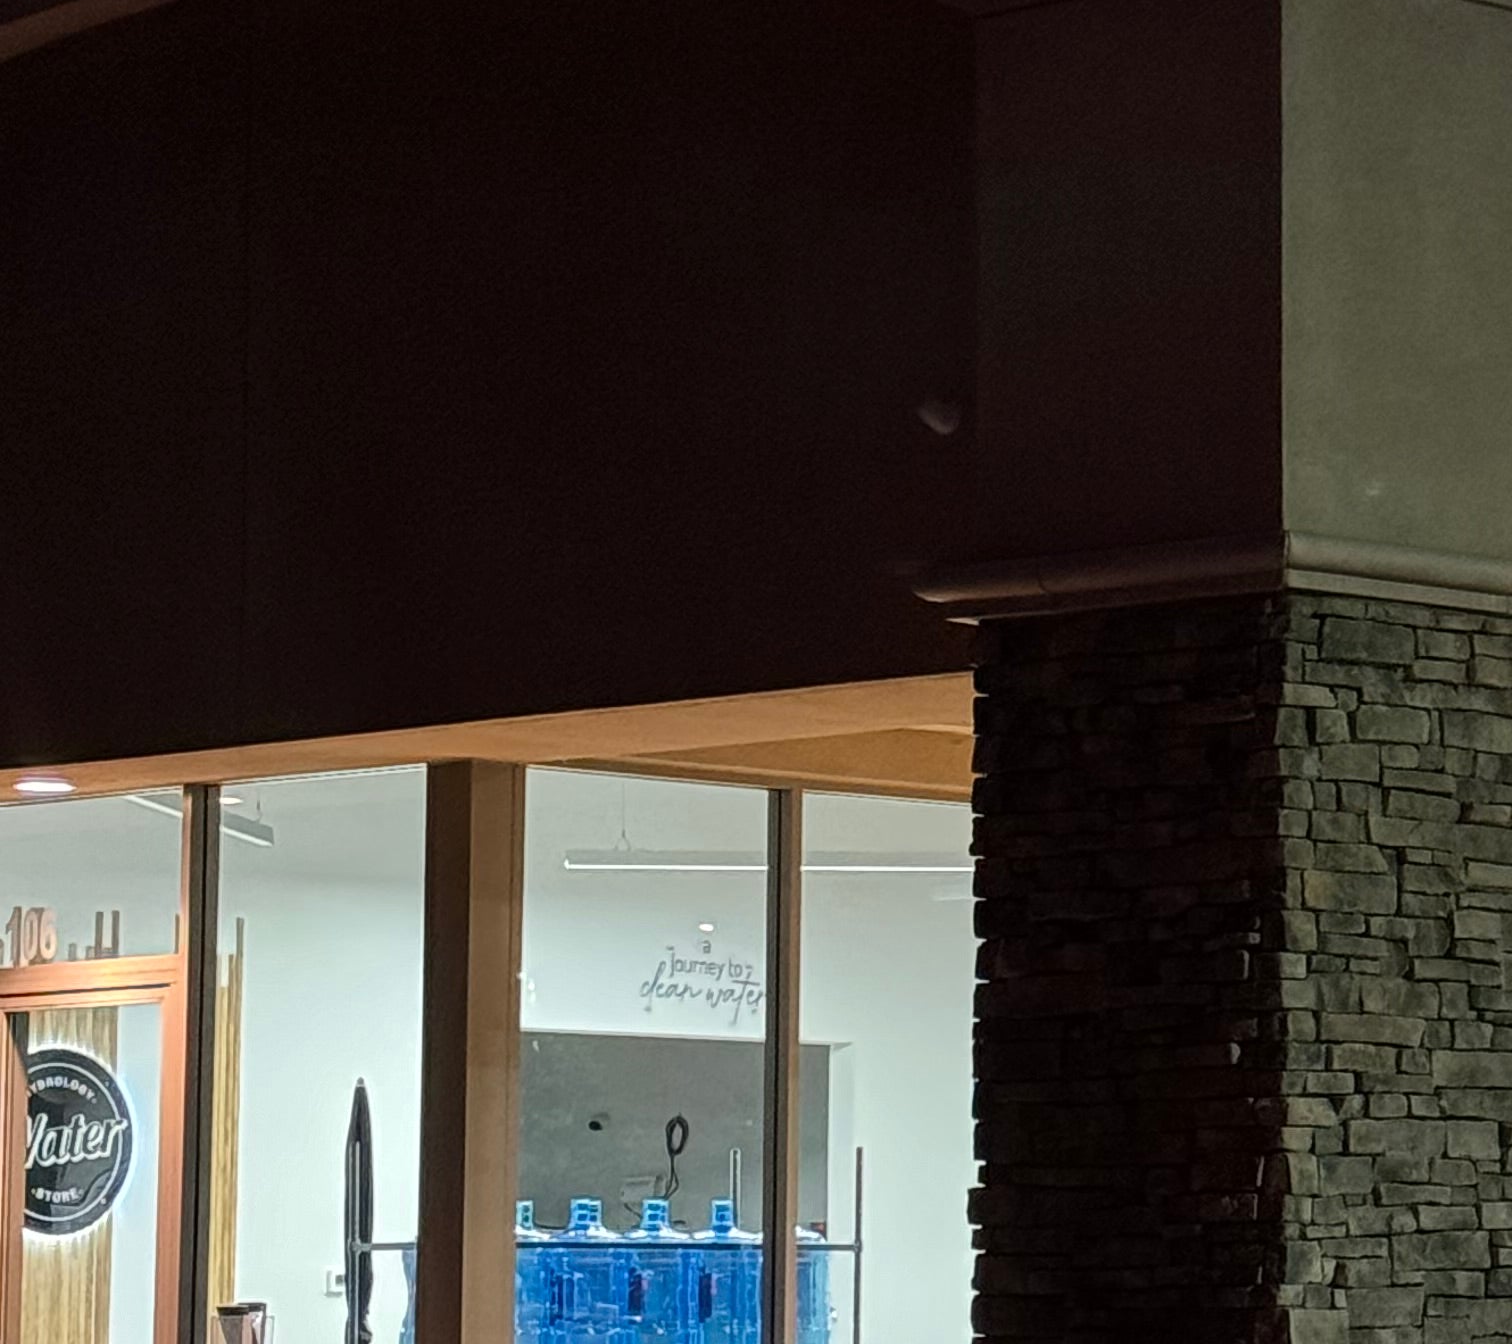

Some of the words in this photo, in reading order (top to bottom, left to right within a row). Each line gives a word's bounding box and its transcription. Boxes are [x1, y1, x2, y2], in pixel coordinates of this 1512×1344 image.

[5, 906, 57, 966] 106
[702, 939, 712, 954] a
[35, 1187, 79, 1204] STORE
